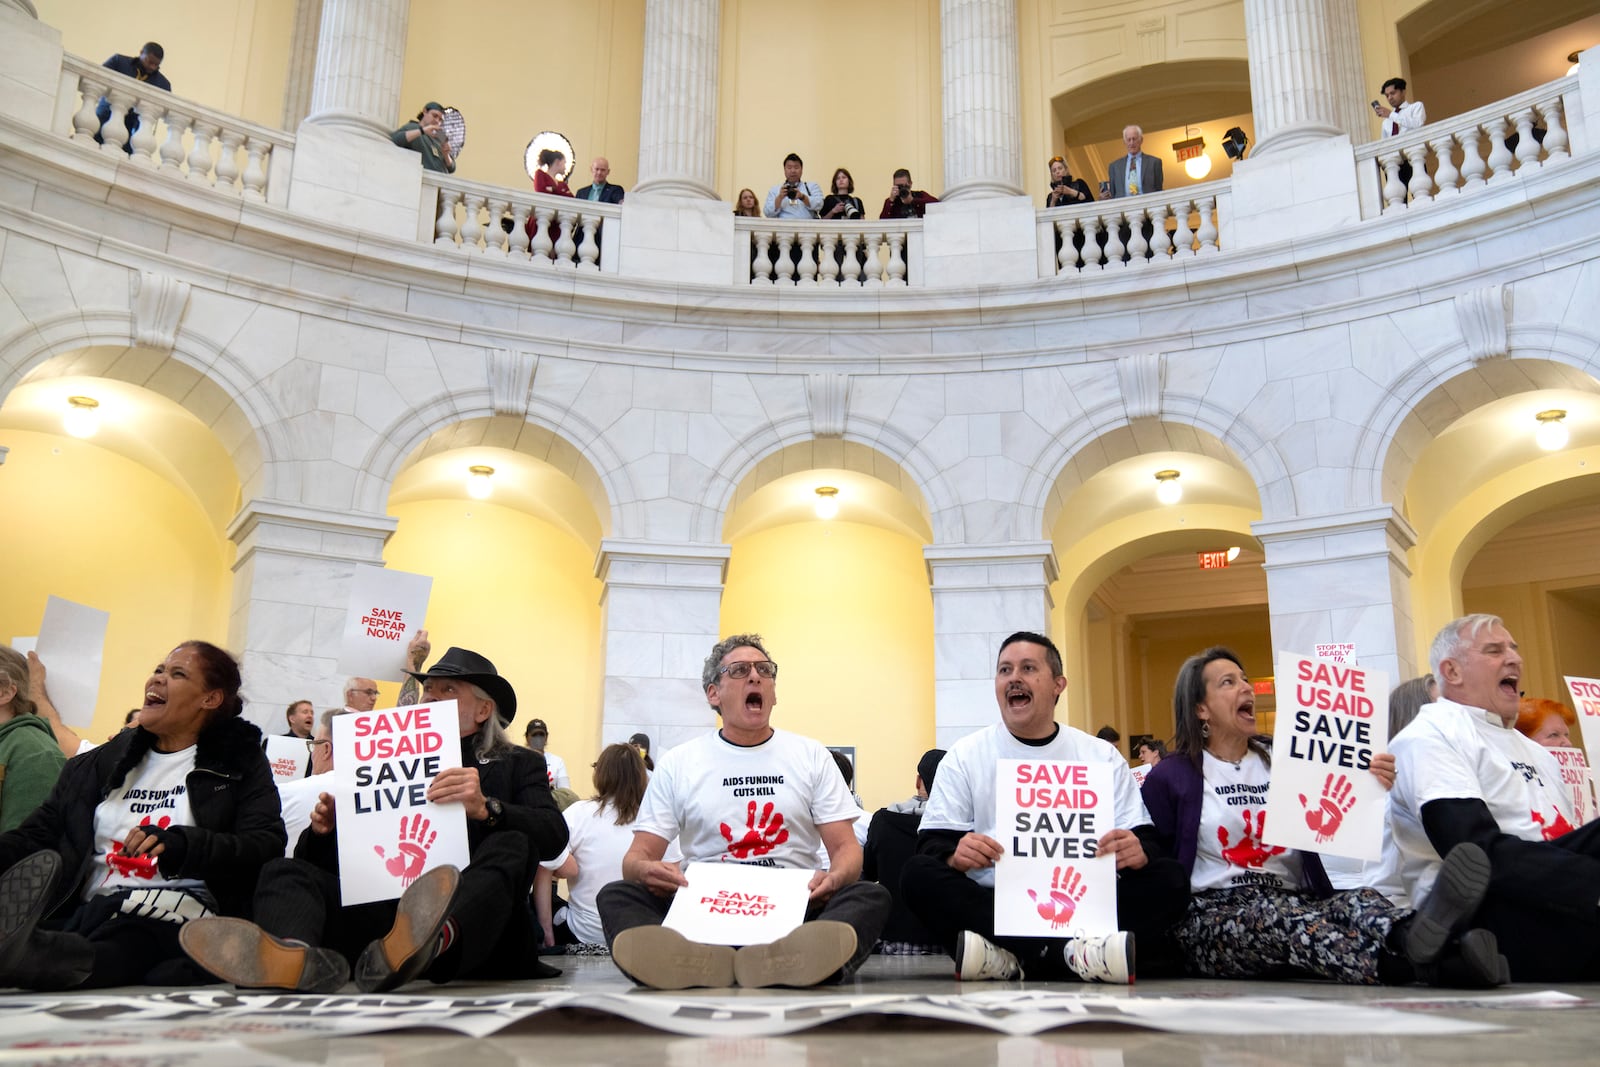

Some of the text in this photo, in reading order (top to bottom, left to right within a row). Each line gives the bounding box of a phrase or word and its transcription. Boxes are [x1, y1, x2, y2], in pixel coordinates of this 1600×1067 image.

[1180, 145, 1200, 160] EXIT
[1204, 553, 1225, 568] EXIT
[371, 608, 403, 621] SAVE
[361, 616, 406, 632] PEPFAR
[367, 627, 400, 641] NOW!
[1298, 660, 1365, 693] SAVE
[1571, 682, 1600, 698] STO
[1297, 684, 1374, 718] USAID
[354, 708, 431, 737] SAVE
[1295, 711, 1370, 745] SAVE
[354, 732, 443, 761] USAID
[1290, 736, 1372, 771] LIVES
[355, 756, 441, 787] SAVE
[1016, 764, 1088, 785] SAVE
[1560, 769, 1583, 785] EADLY
[723, 776, 784, 786] AIDS FUNDING
[122, 790, 148, 800] AIDS
[734, 787, 776, 797] CUTS KILL
[1215, 784, 1236, 795] AIDS
[354, 783, 434, 815] LIVE
[1015, 788, 1098, 809] USAID
[1227, 795, 1267, 806] CUTS KILL
[1015, 812, 1096, 834] SAVE
[1013, 836, 1098, 859] LIVES
[700, 897, 776, 910] PEPFAR
[717, 890, 769, 903] SAVE
[709, 907, 768, 917] NOW!
